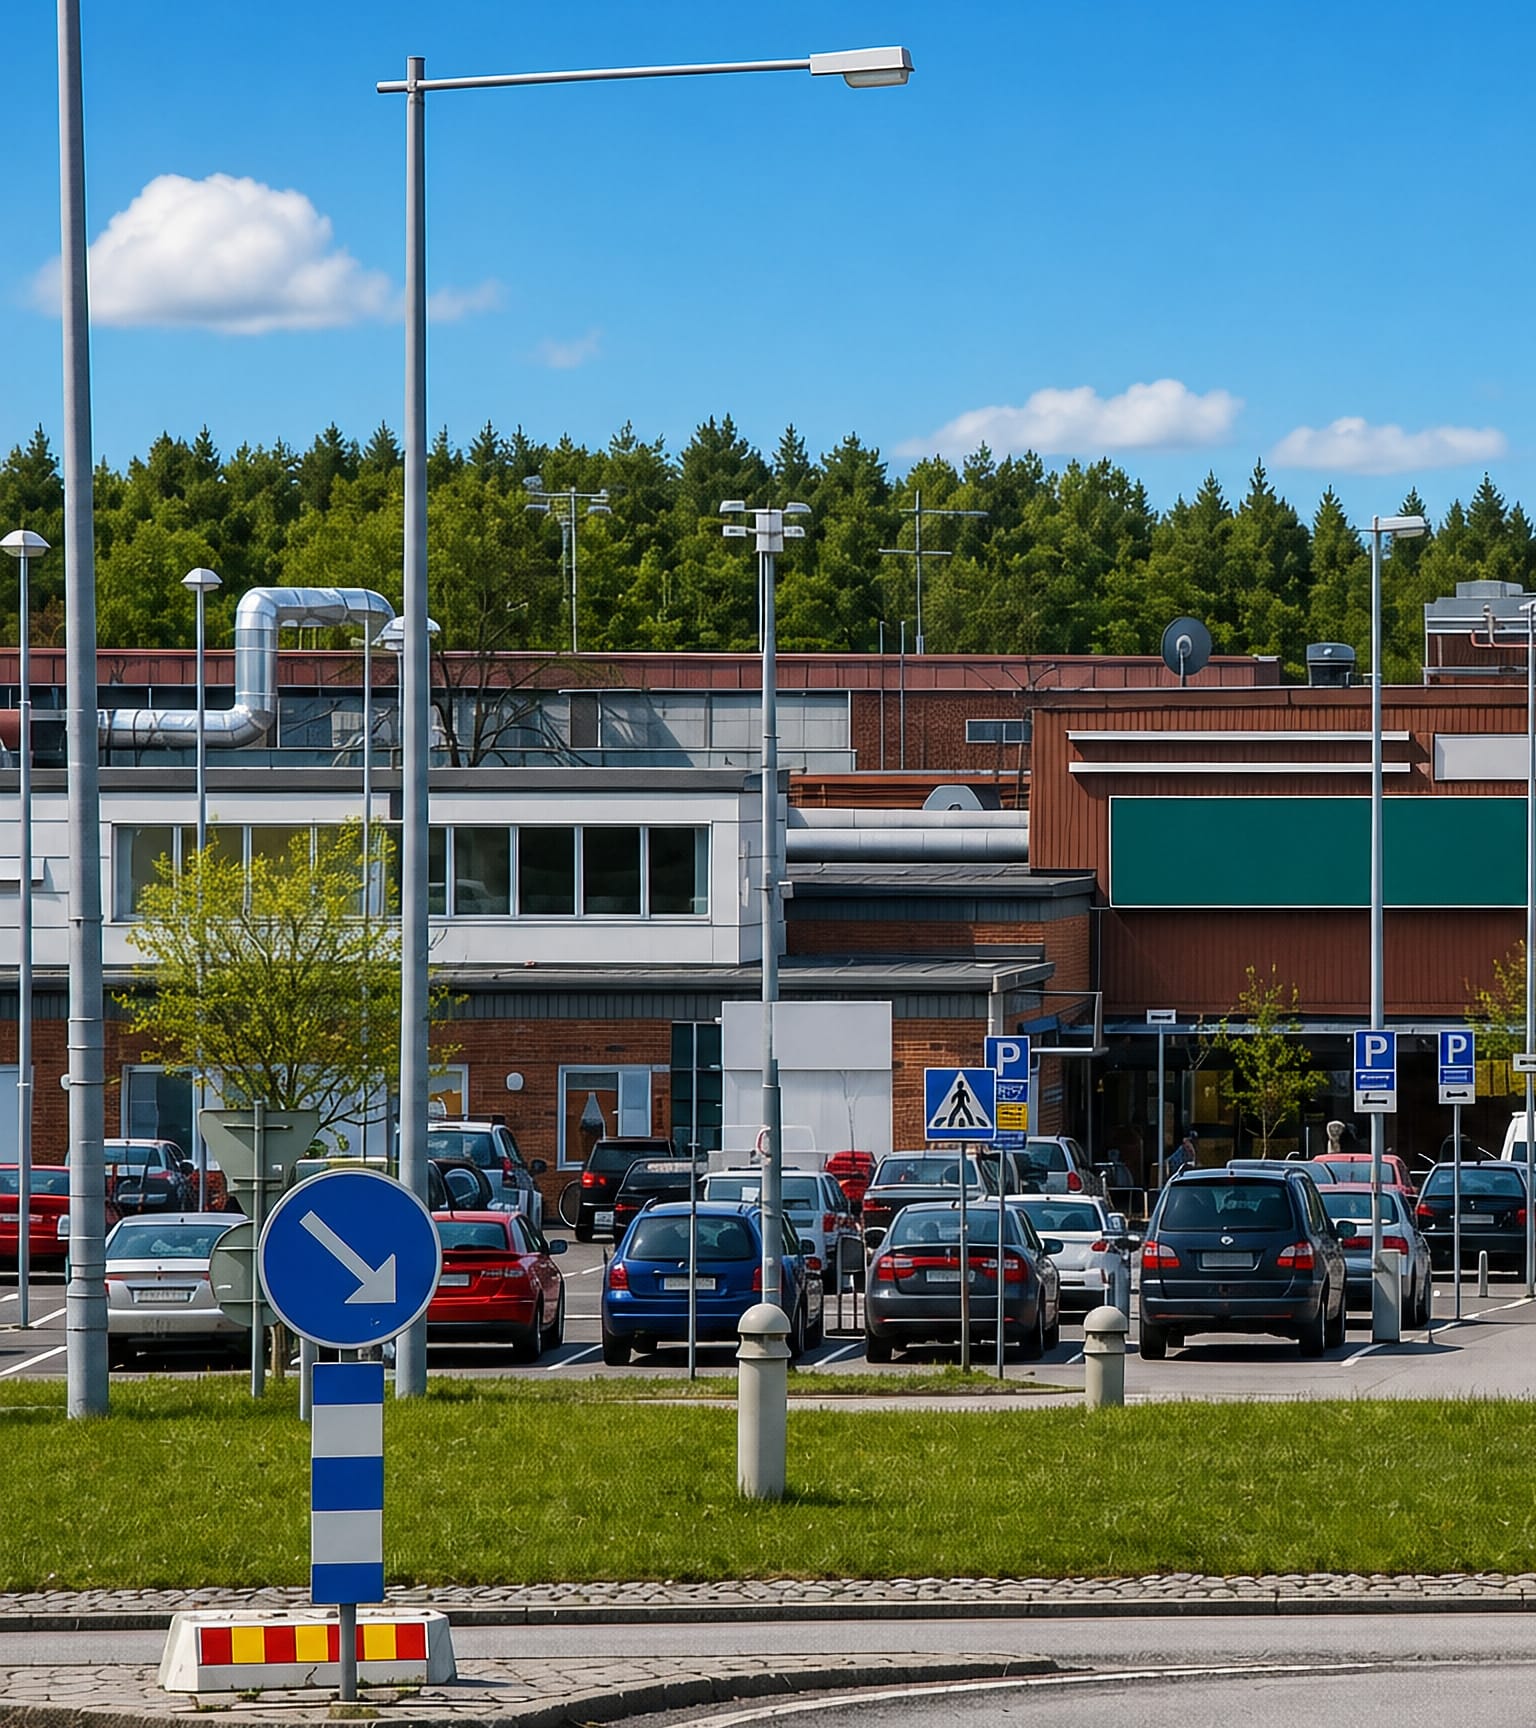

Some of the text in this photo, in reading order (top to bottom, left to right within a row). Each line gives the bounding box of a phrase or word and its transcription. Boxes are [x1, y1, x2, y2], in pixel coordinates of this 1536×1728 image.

[997, 1042, 1021, 1076] P
[1366, 1035, 1388, 1067] P
[1447, 1035, 1467, 1064] P
